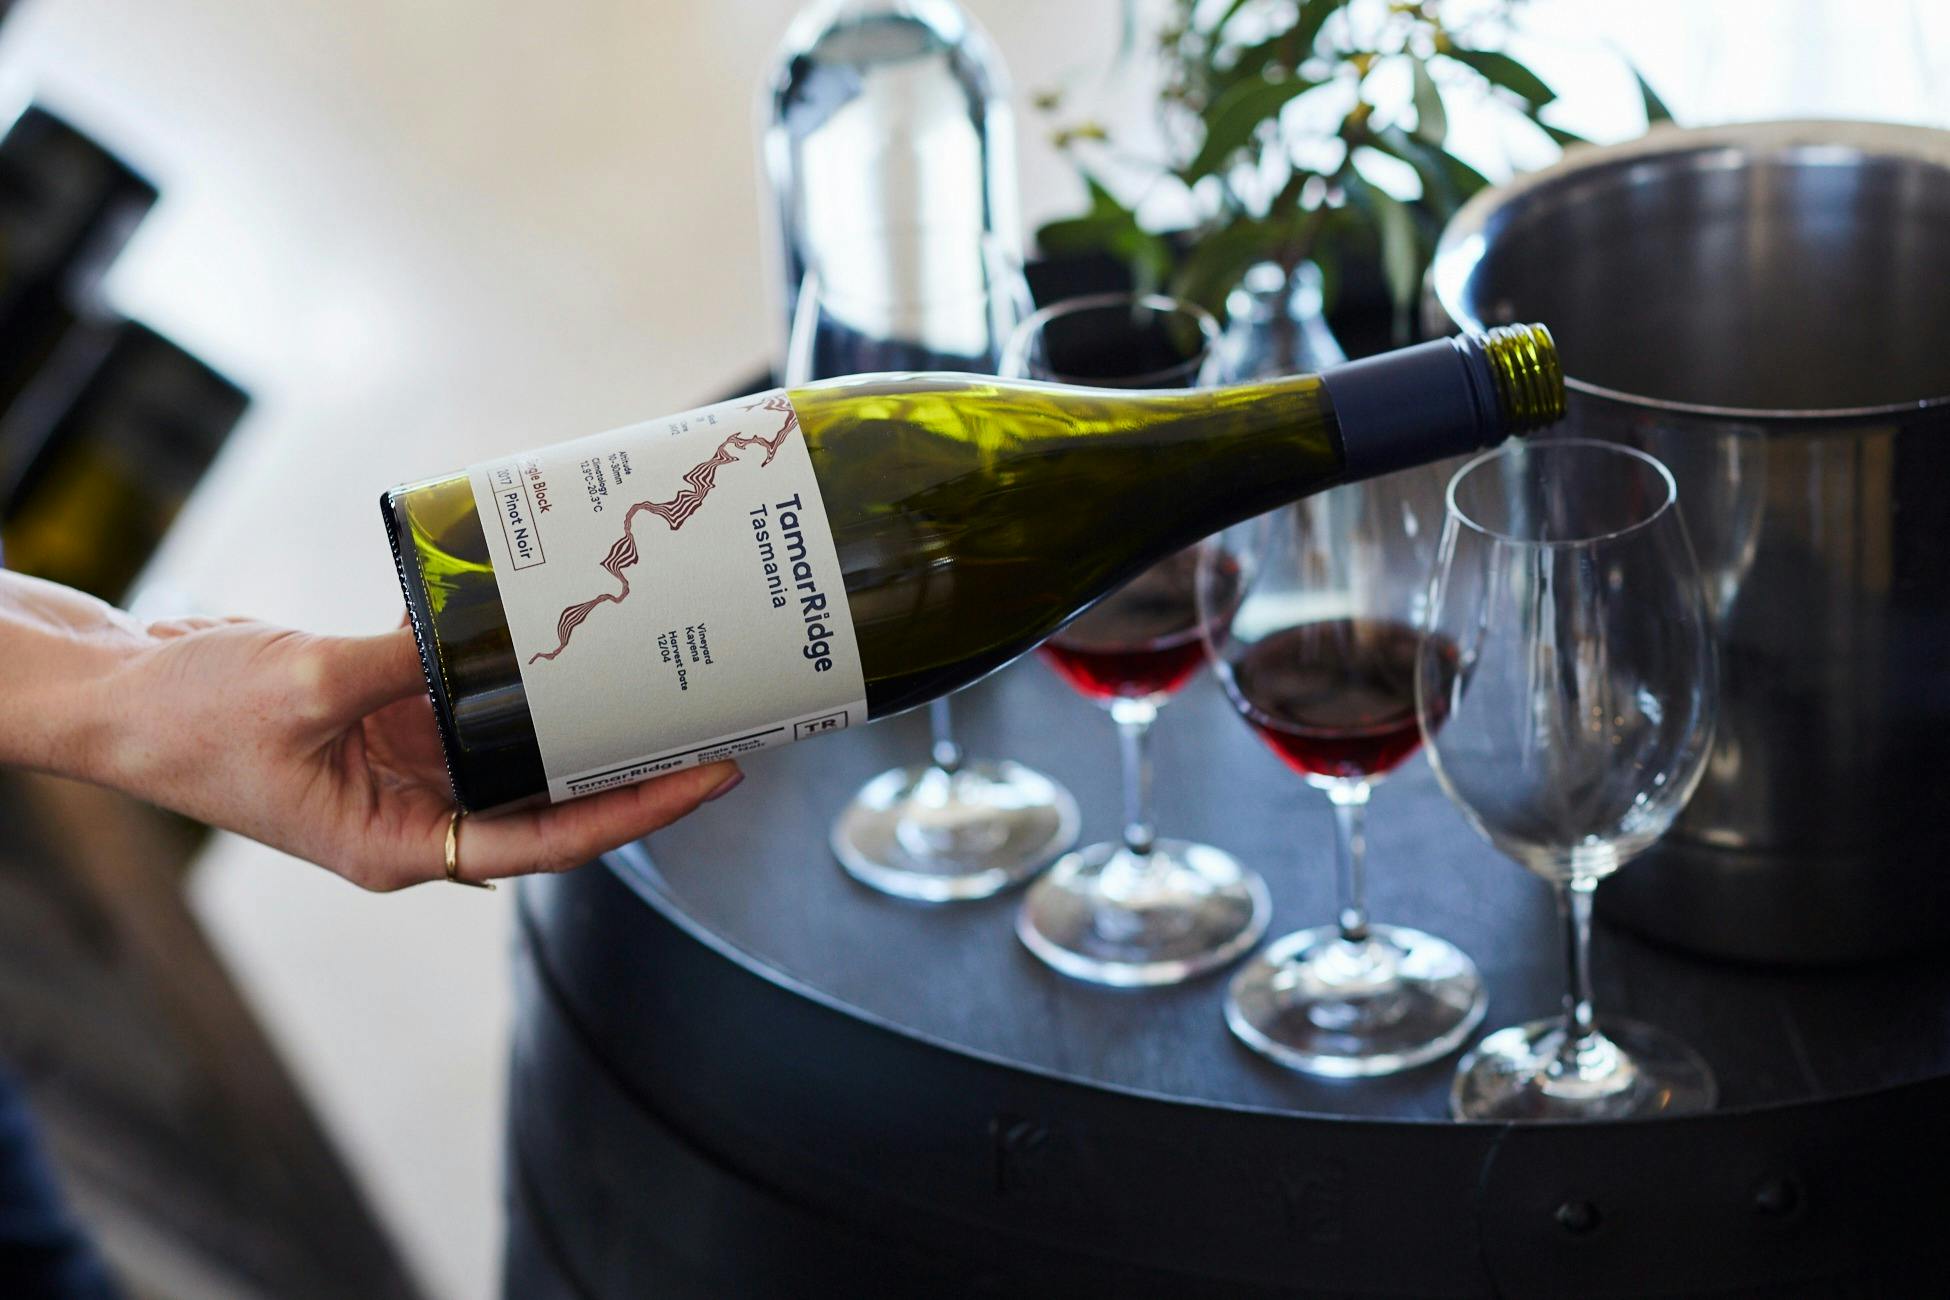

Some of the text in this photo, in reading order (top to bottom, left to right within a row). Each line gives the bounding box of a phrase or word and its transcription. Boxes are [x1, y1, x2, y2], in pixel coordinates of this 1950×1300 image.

[591, 457, 608, 496] Climatology
[619, 451, 632, 475] Altitude
[533, 481, 552, 514] Block
[504, 492, 533, 559] Pinot Noir
[749, 503, 788, 609] Tasmania
[775, 493, 834, 673] TamarRidge
[657, 633, 671, 663] 12/04
[668, 630, 688, 691] Harvest Date
[685, 626, 700, 663] Kayena
[697, 622, 714, 665] Vineyard
[804, 718, 837, 733] TR
[567, 760, 683, 792] TamarRidge
